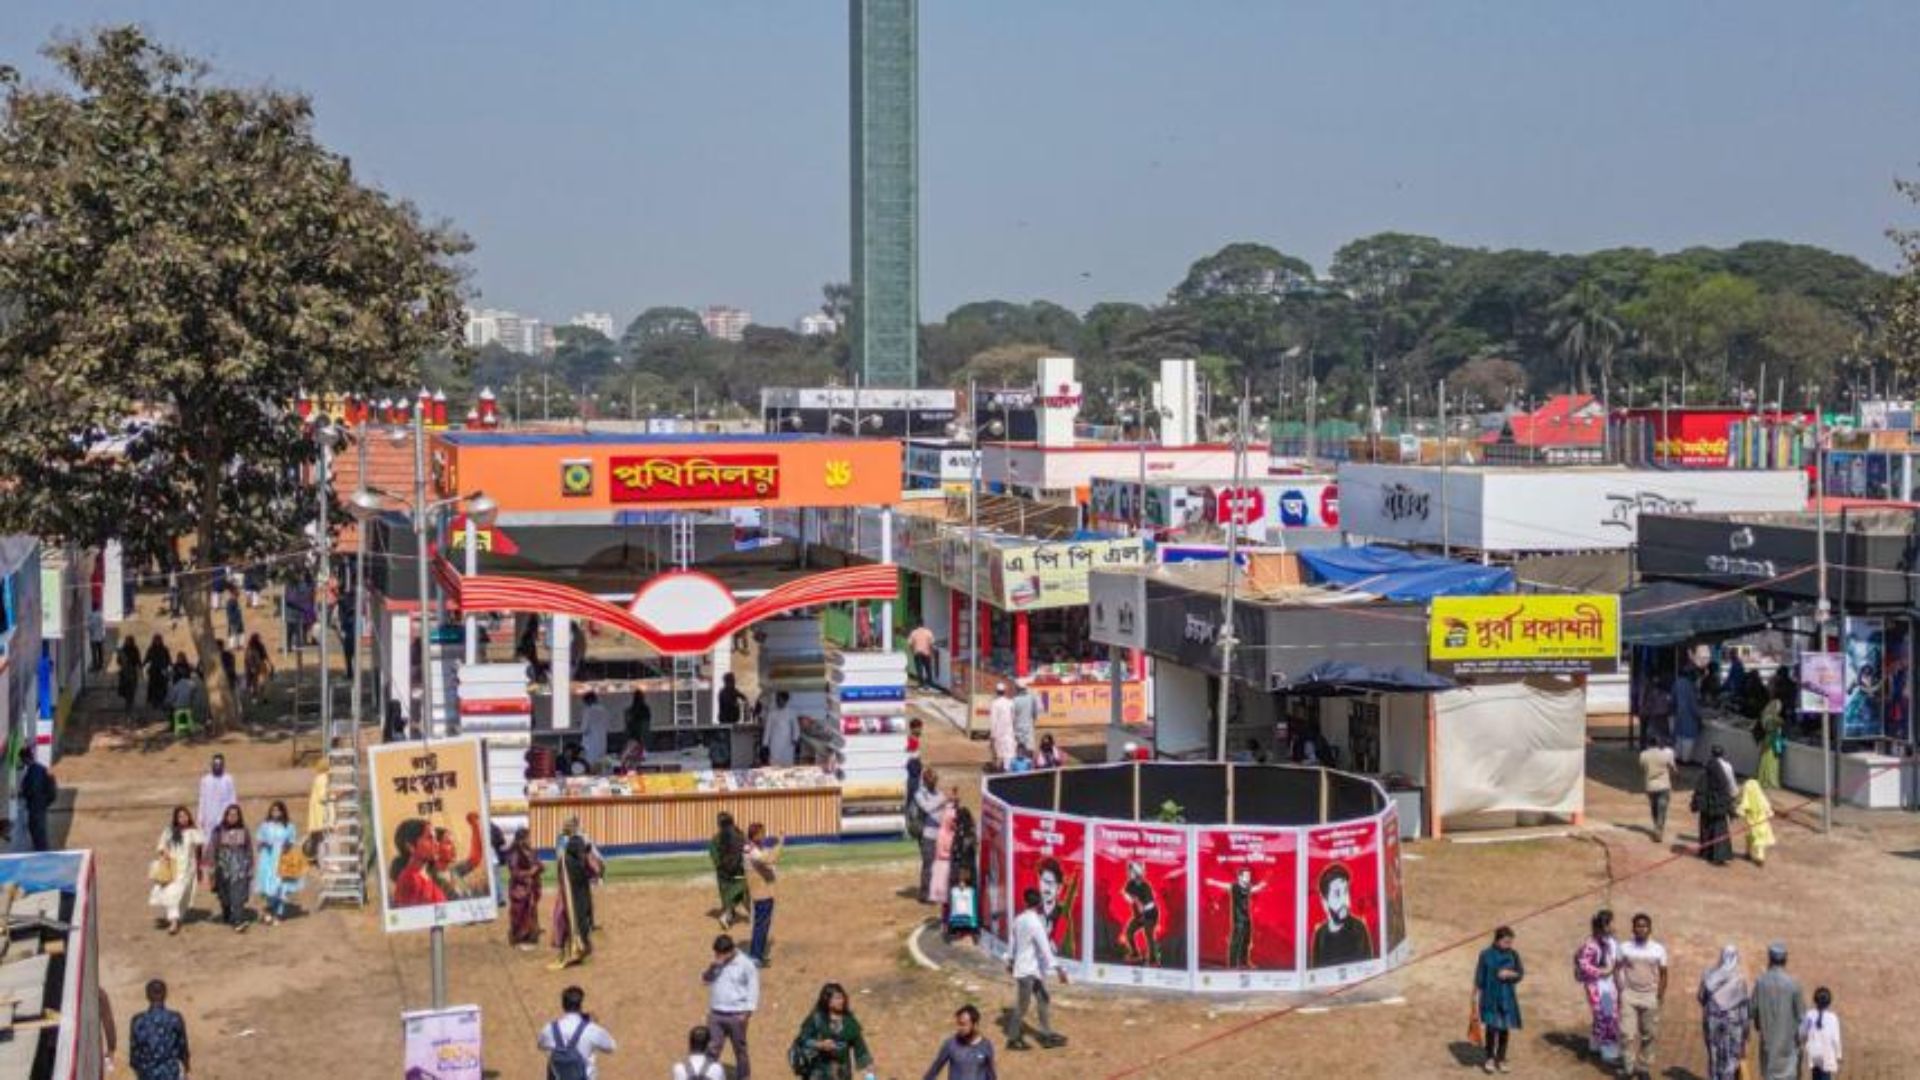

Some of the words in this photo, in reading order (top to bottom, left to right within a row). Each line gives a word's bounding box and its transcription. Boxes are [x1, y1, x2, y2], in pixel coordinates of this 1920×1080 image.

[1005, 556, 1023, 572] এ
[1033, 544, 1058, 570] পি
[1067, 545, 1092, 569] পি
[1102, 546, 1140, 564] এল
[1522, 602, 1604, 642] প্রকাশনী
[392, 771, 457, 794] সংস্কার
